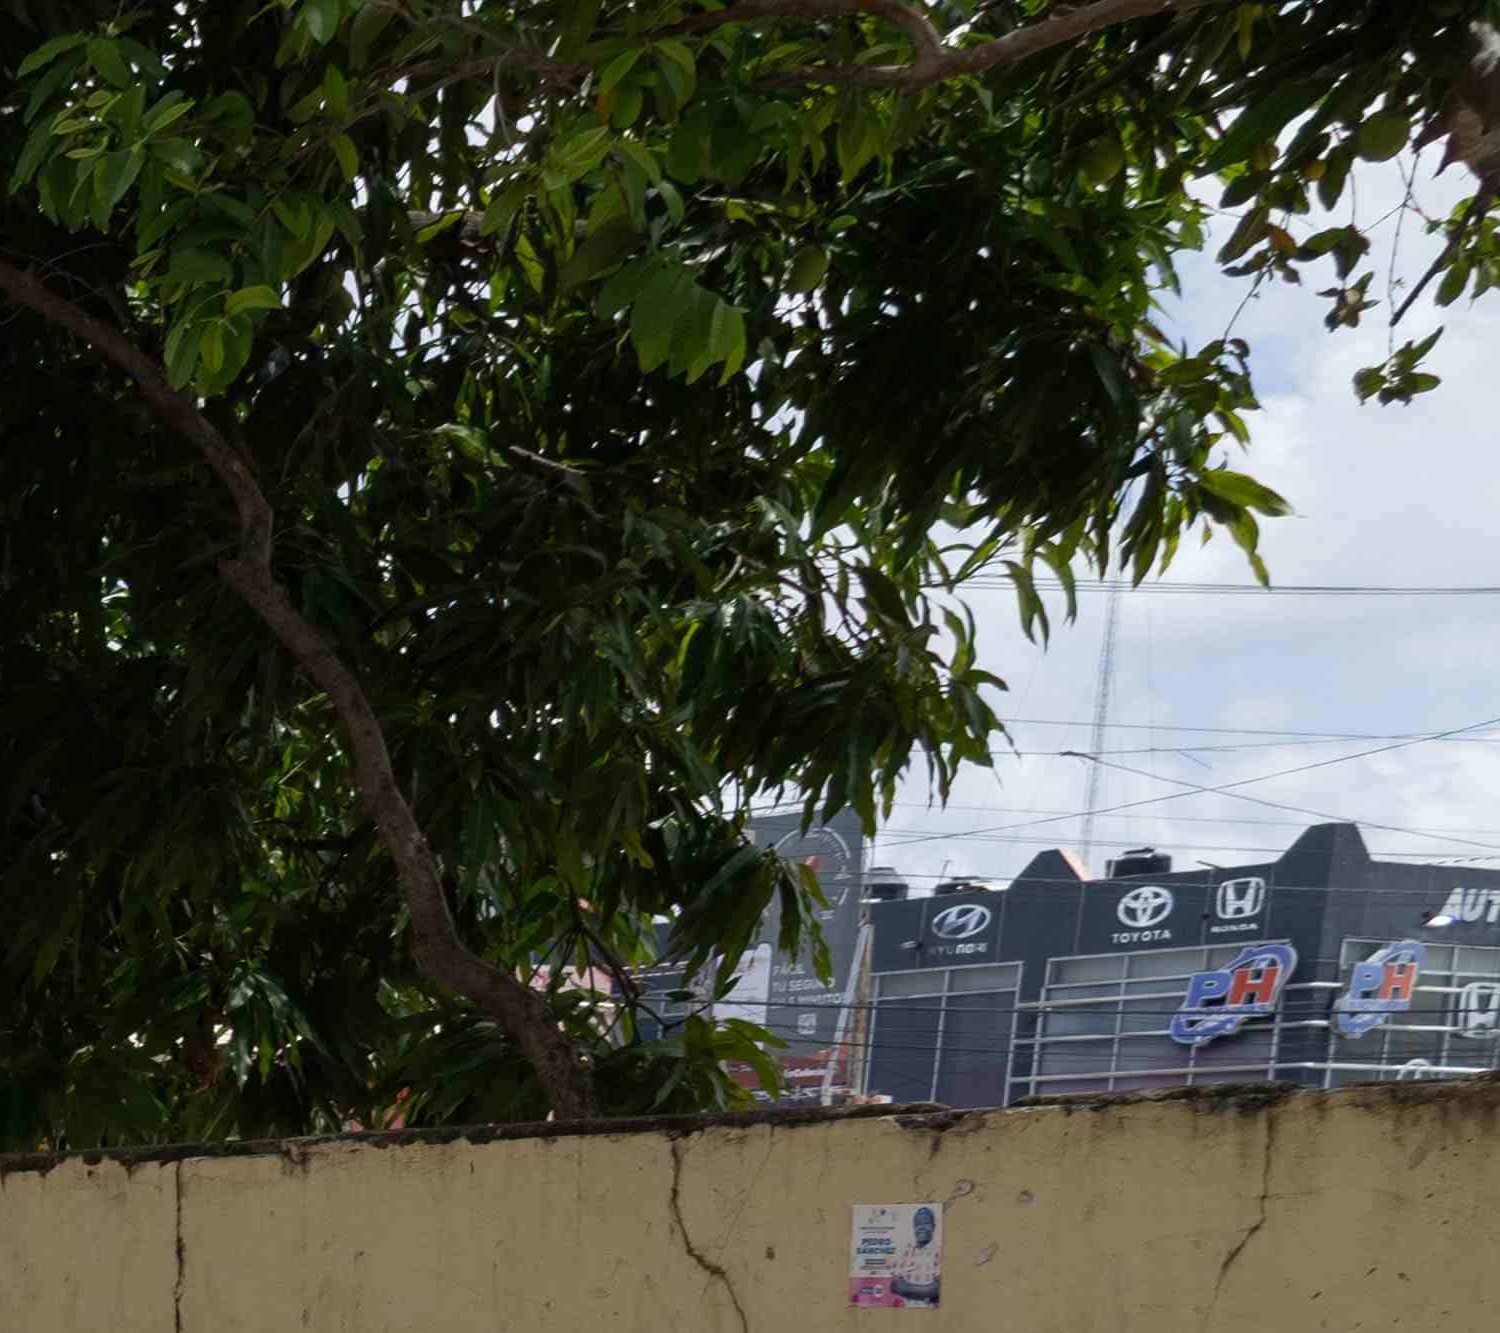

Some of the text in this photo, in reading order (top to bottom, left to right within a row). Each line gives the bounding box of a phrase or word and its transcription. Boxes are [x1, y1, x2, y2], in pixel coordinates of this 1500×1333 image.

[1111, 929, 1172, 945] TOYOTA
[1184, 965, 1279, 1010] PH
[1351, 962, 1418, 1001] PH
